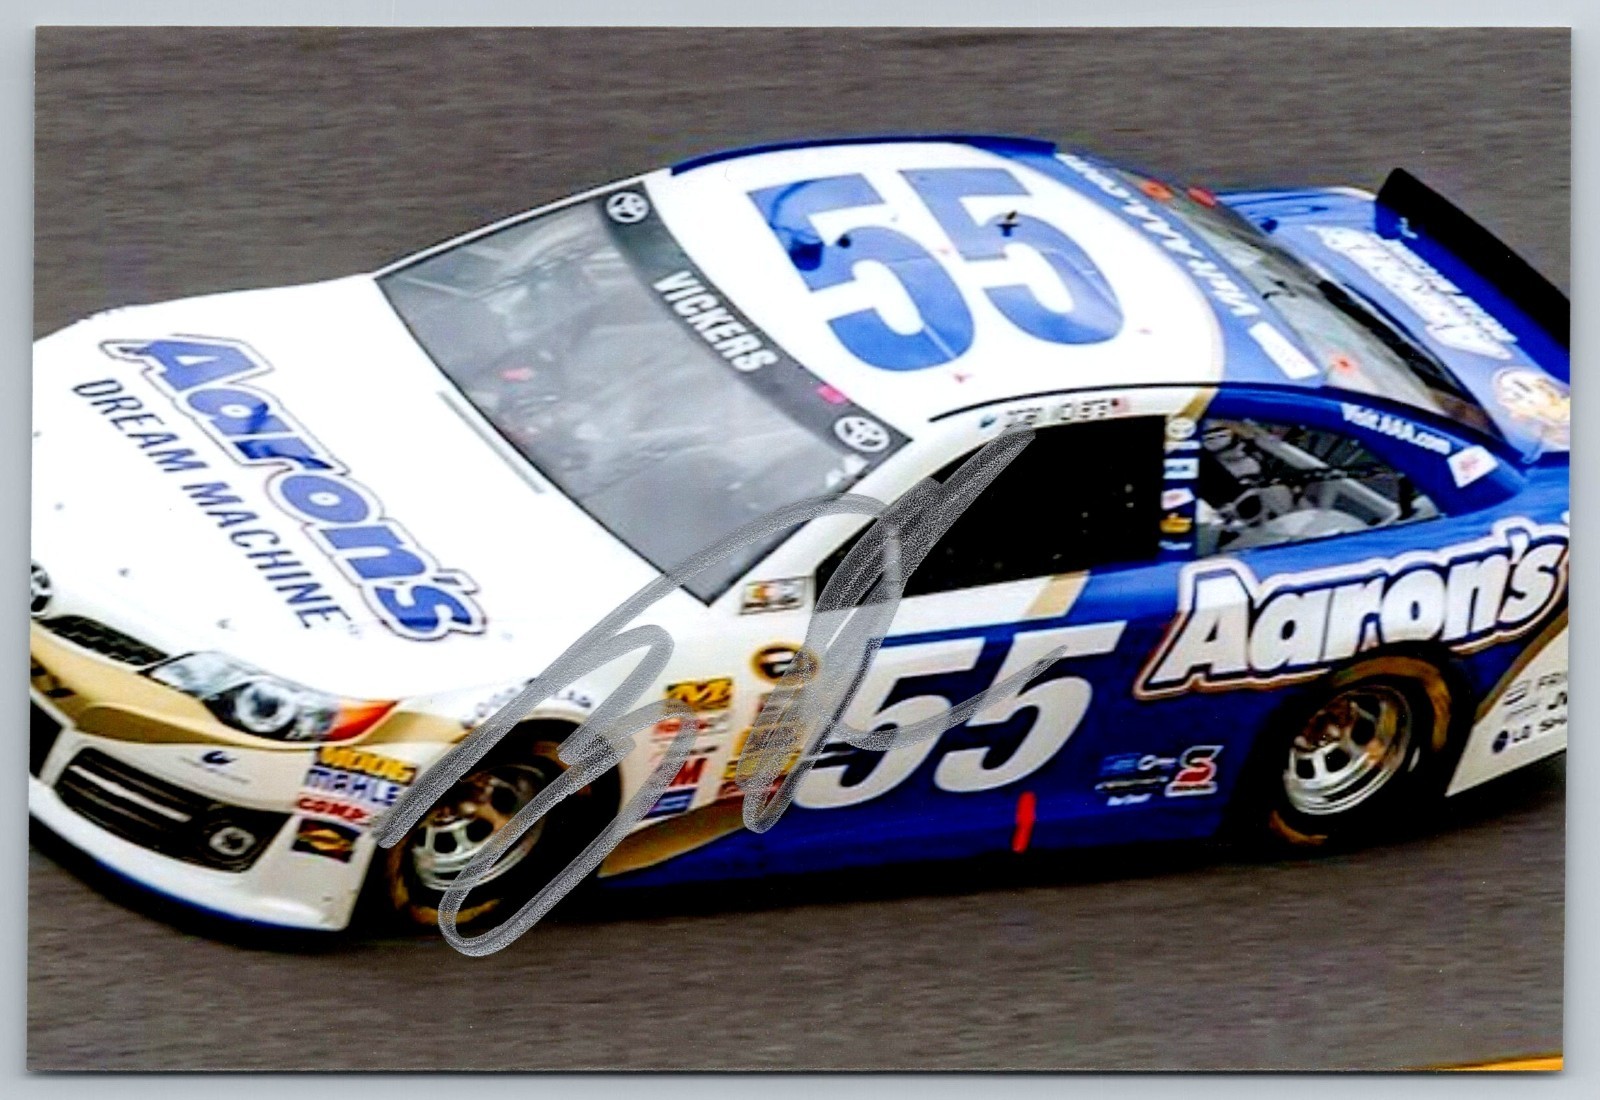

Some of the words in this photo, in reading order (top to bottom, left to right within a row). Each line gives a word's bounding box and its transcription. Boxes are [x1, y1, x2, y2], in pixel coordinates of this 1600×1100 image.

[653, 271, 778, 372] VICKERS
[747, 167, 1125, 371] 55
[72, 378, 209, 472] DREAM
[181, 481, 351, 630] MACHINE
[112, 336, 479, 637] Aaron's
[1145, 526, 1568, 687] Aaron's
[791, 621, 1127, 808] 55
